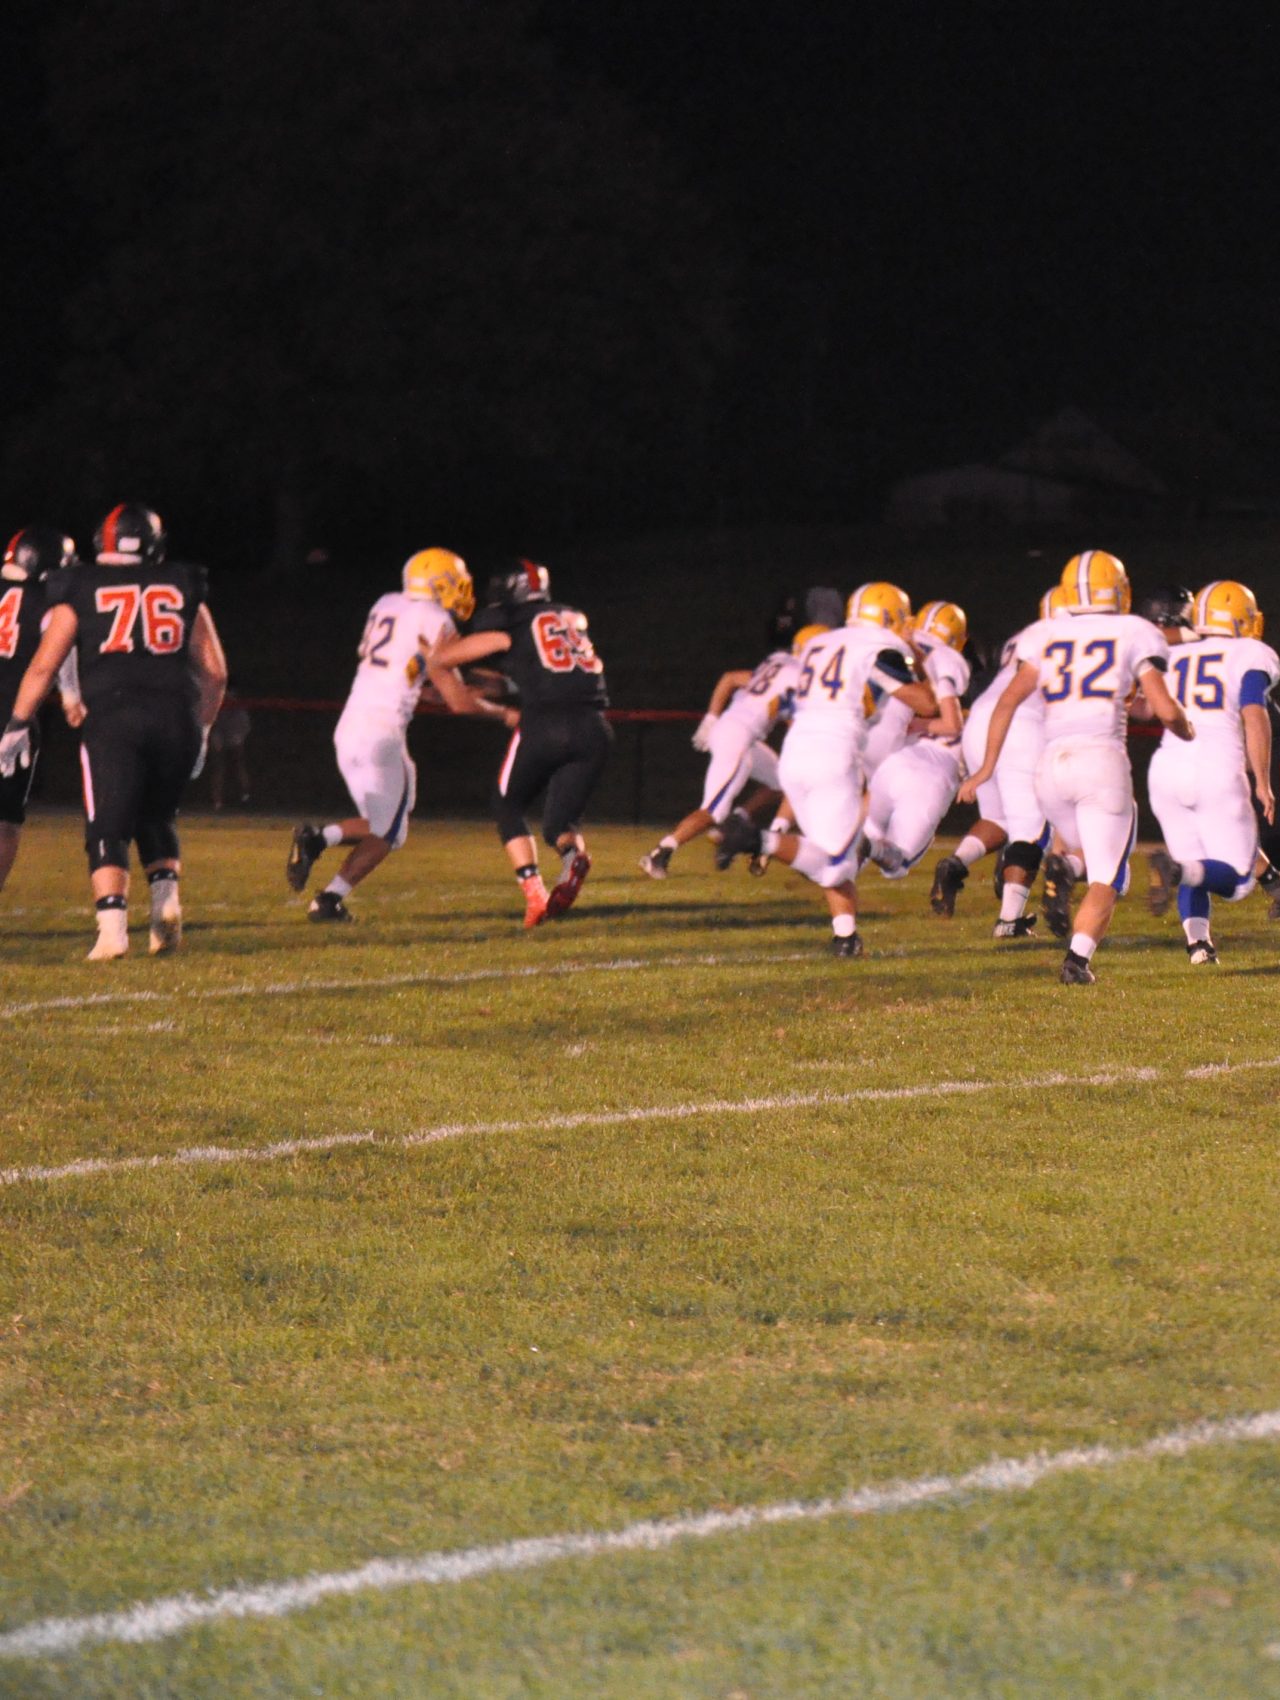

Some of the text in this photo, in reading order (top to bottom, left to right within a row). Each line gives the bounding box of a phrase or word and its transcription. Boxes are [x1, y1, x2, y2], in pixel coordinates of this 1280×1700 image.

[95, 584, 184, 655] 76
[358, 612, 396, 669] 2
[797, 645, 846, 700] 54
[1040, 638, 1118, 703] 32
[1173, 651, 1225, 711] 15
